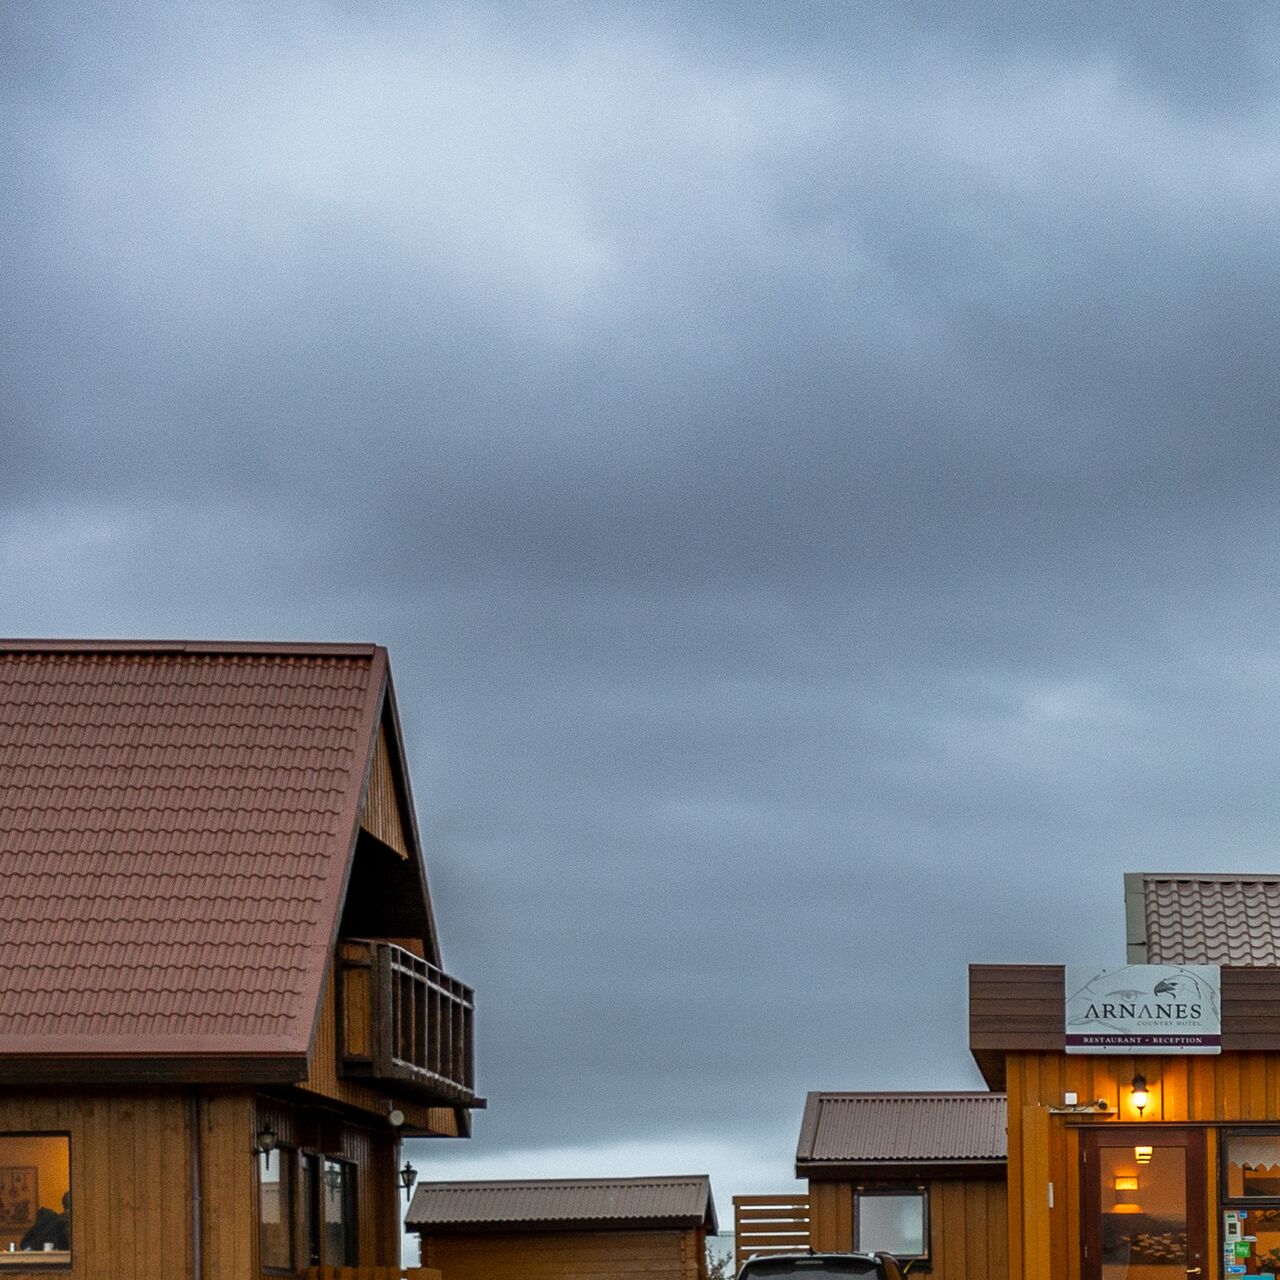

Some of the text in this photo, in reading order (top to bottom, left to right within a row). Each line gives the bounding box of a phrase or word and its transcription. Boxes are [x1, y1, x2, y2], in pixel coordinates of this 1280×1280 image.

[1084, 1003, 1202, 1020] ARNANES
[1083, 1036, 1142, 1044] RESTAURANT
[1152, 1036, 1203, 1044] RECEPTION
